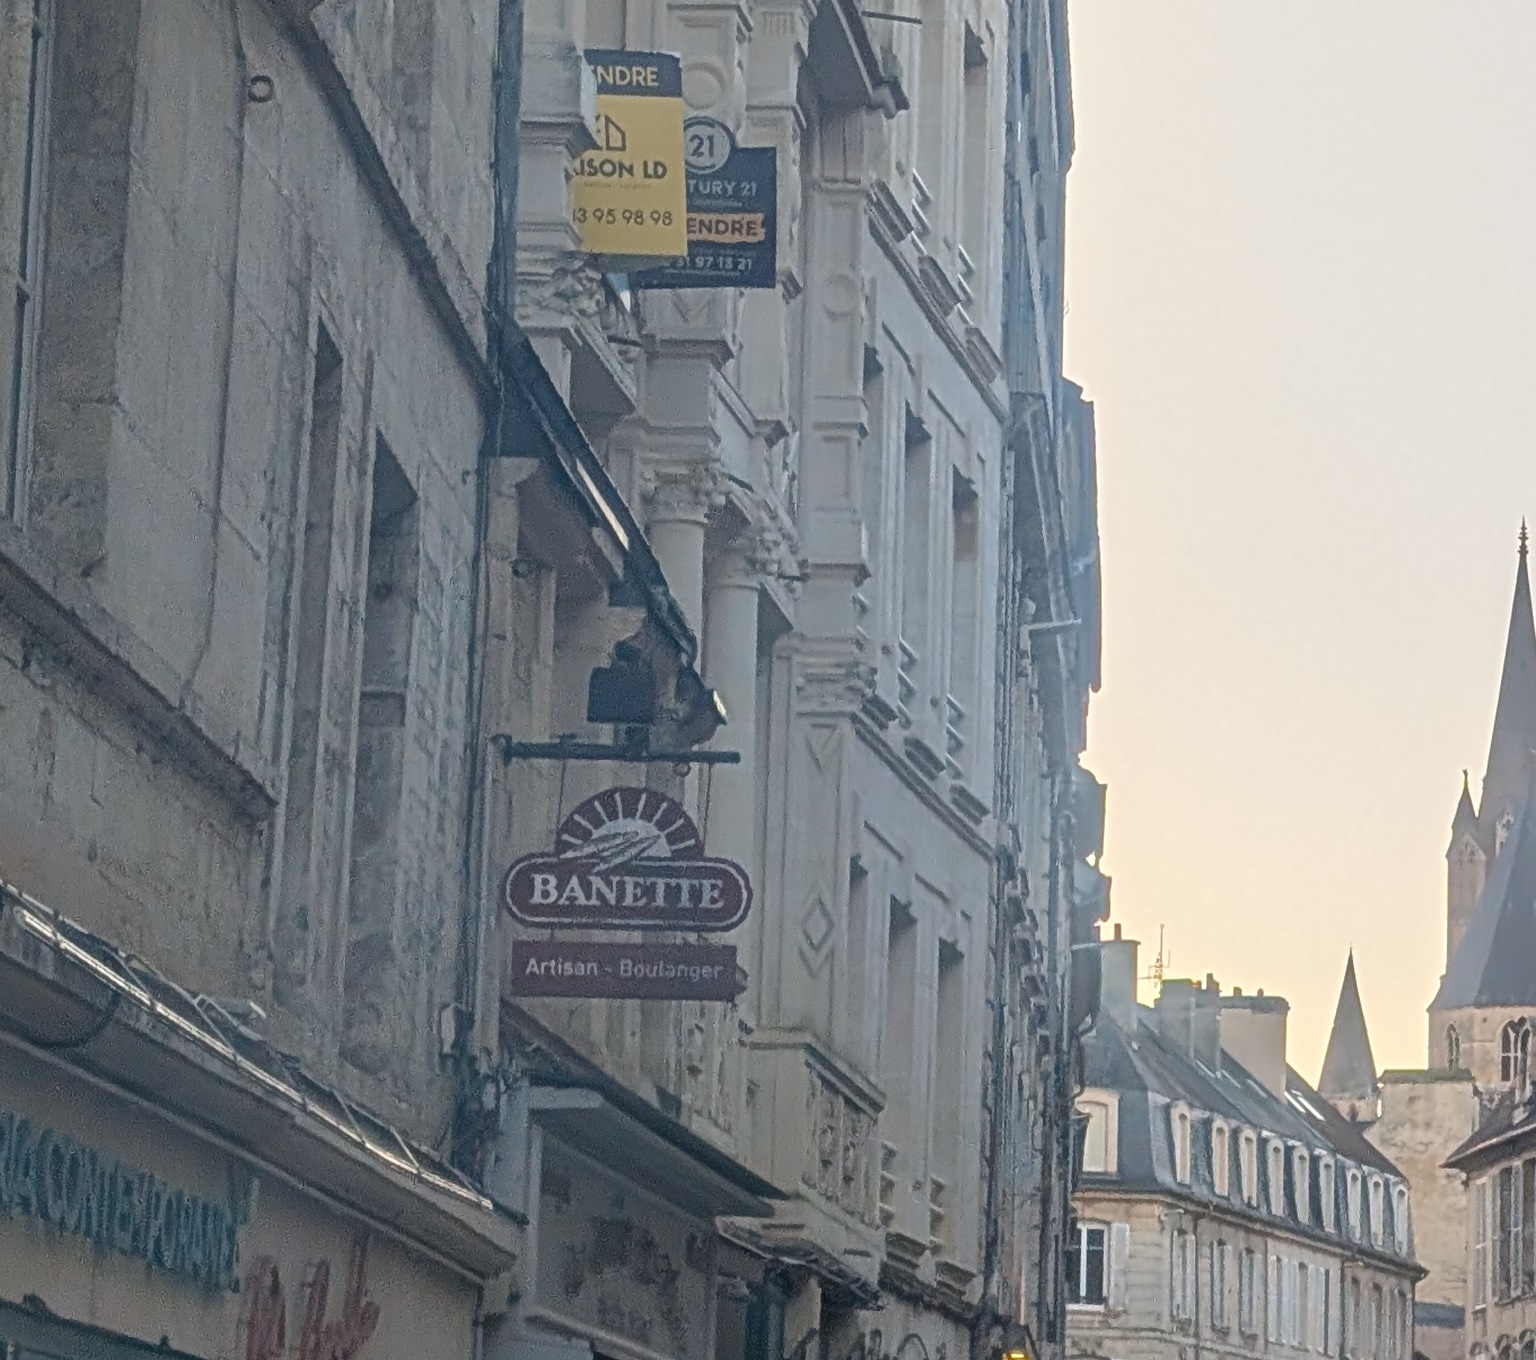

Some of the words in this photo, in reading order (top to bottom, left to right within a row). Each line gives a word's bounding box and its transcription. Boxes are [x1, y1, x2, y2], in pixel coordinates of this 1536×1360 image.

[591, 65, 659, 87] NDRE
[689, 134, 715, 158] 21
[573, 158, 634, 179] ISON
[642, 159, 668, 180] LD
[741, 182, 757, 197] 21
[593, 207, 616, 225] 95
[622, 208, 645, 226] 98
[650, 209, 673, 227] 98
[529, 873, 725, 910] BANETTE
[525, 957, 598, 977] Artisan
[619, 957, 724, 981] Boulanger
